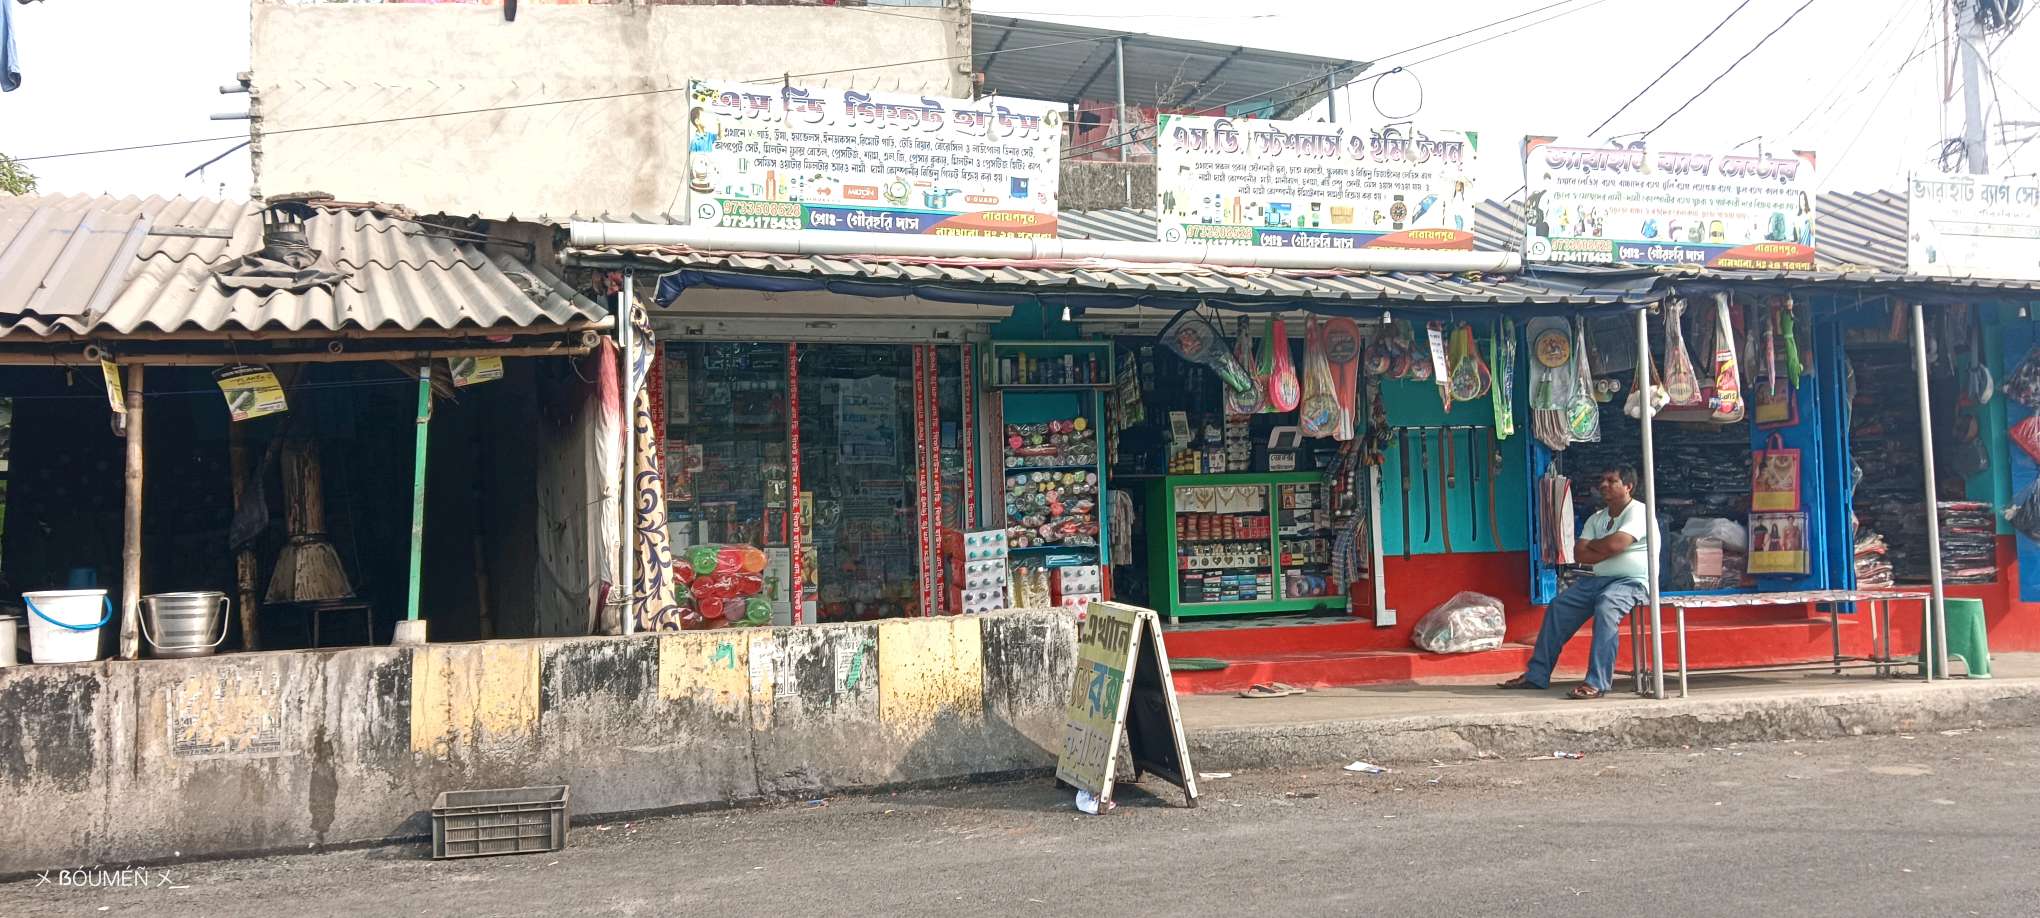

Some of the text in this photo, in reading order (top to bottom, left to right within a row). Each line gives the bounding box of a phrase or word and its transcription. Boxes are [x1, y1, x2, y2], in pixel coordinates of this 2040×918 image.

[724, 128, 745, 138] এখানে
[1346, 135, 1365, 161] ও
[1980, 184, 2010, 210] ব্যাগ
[895, 217, 919, 231] দাস
